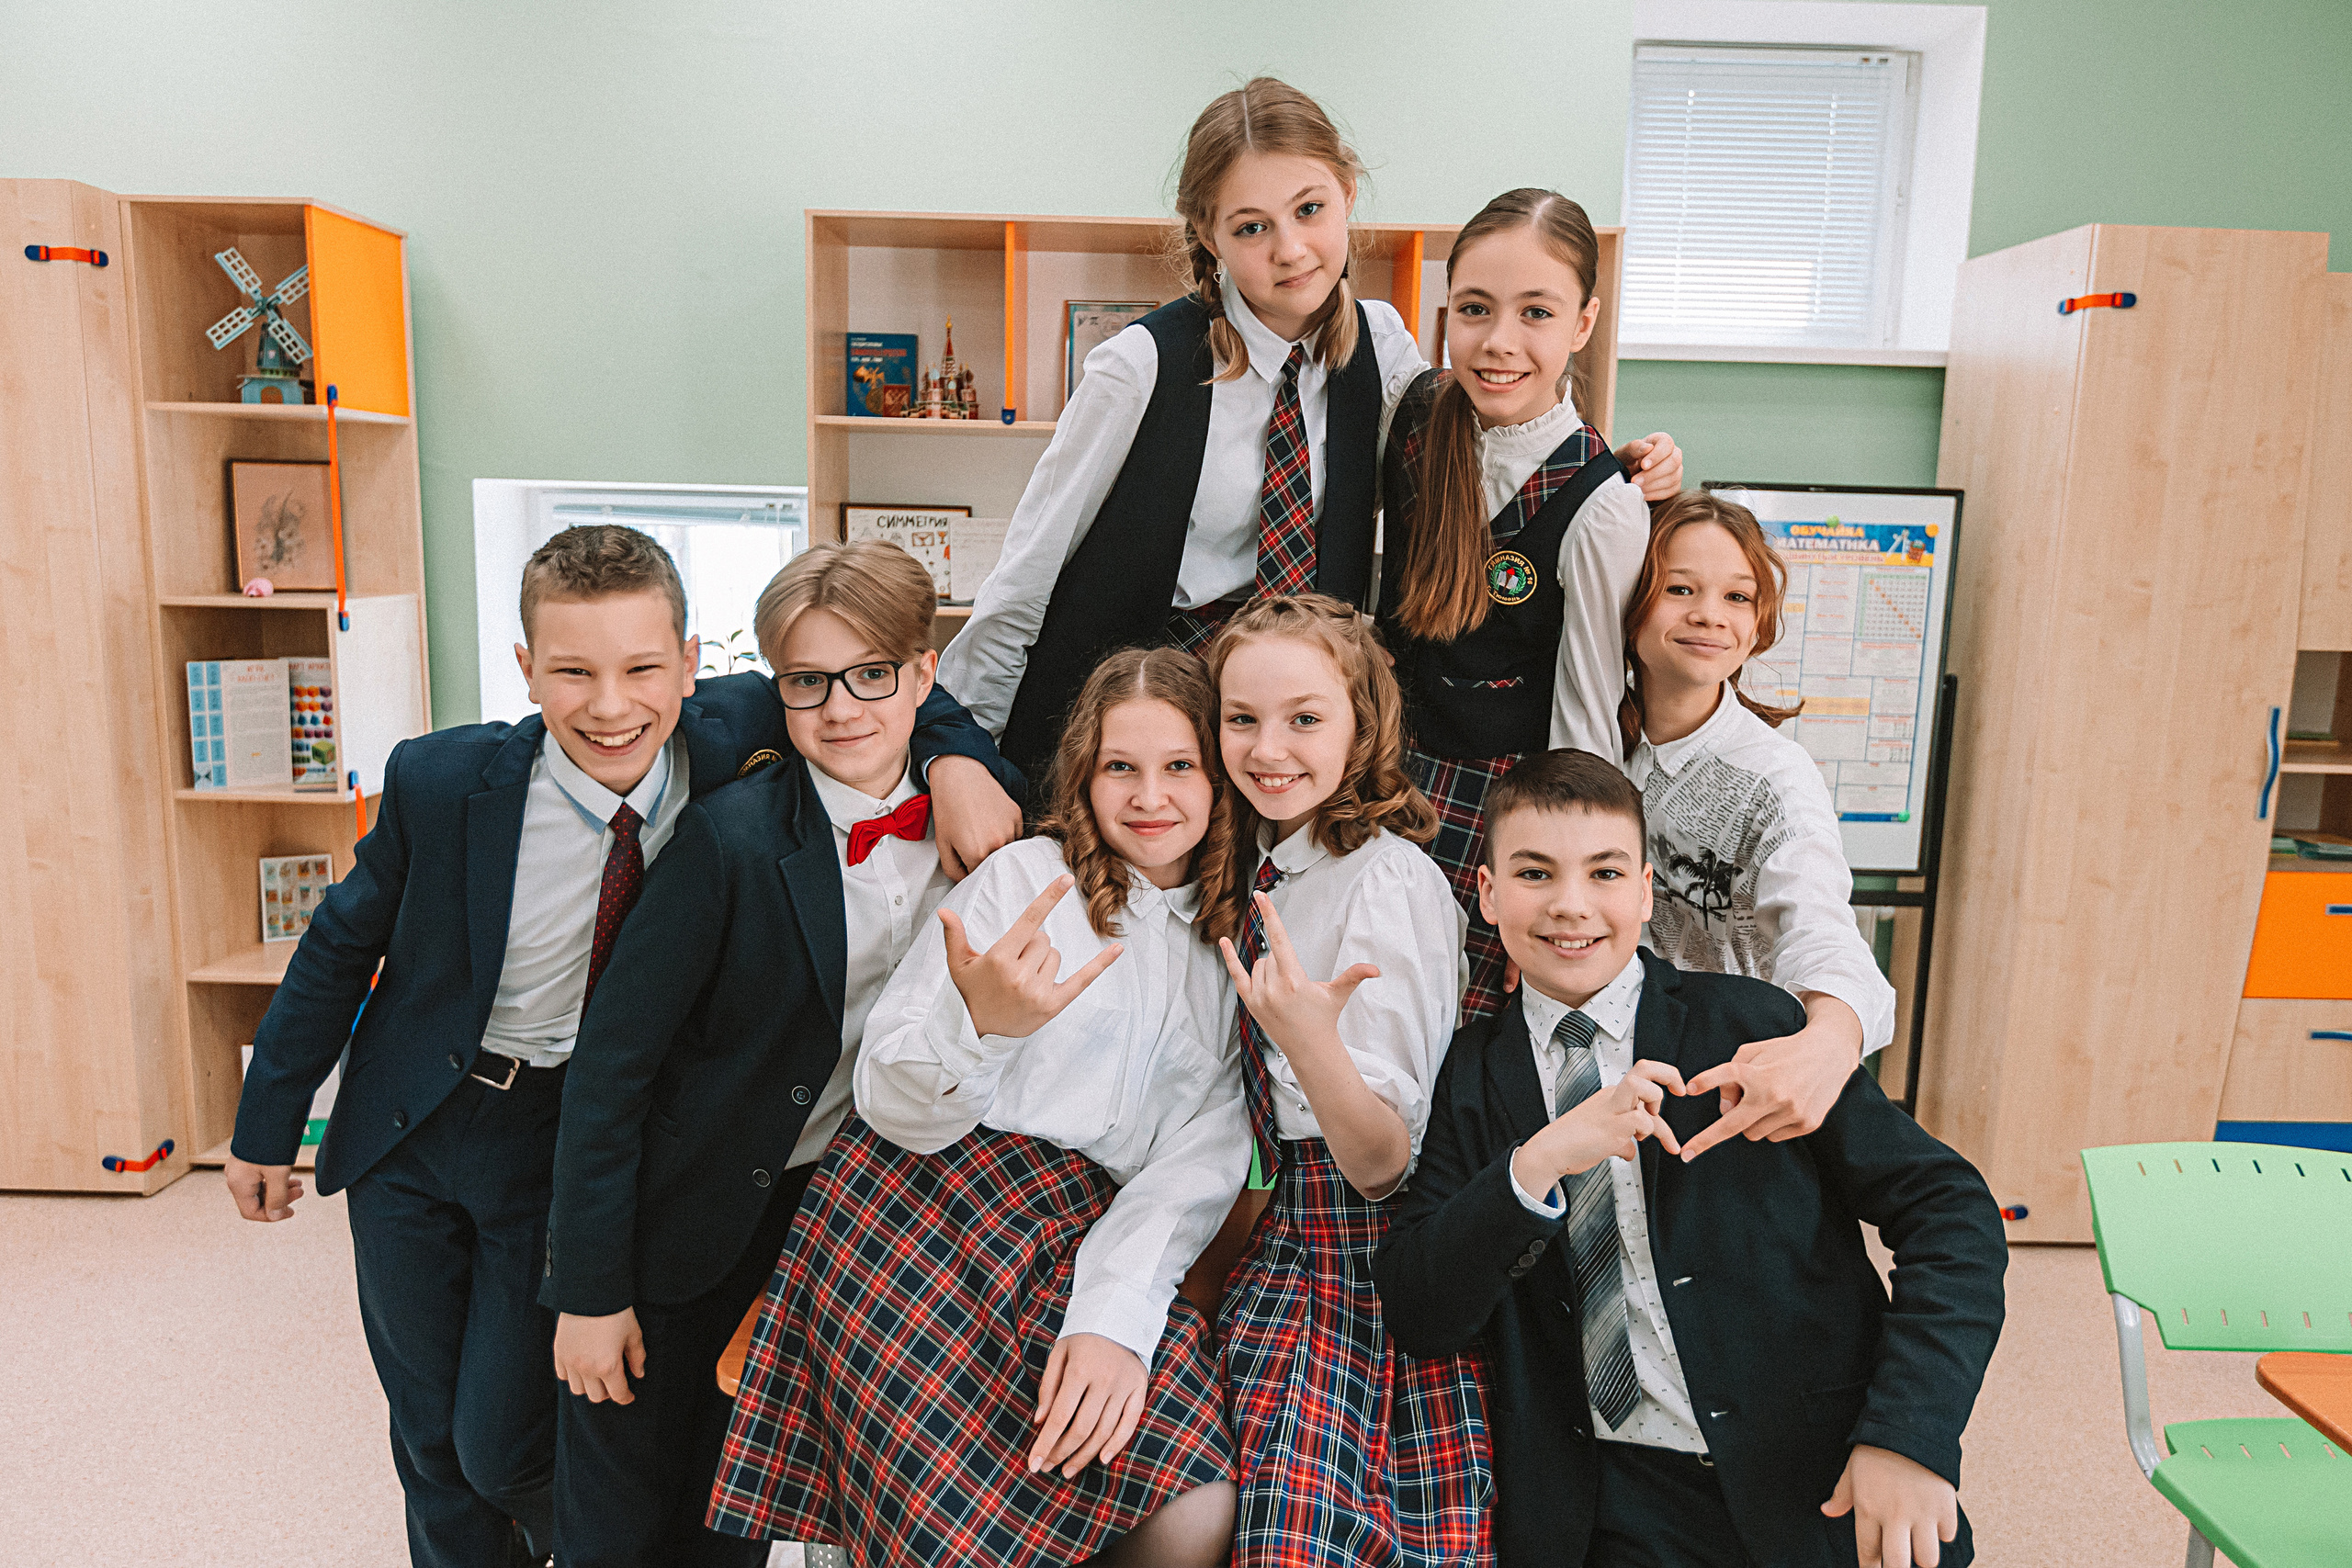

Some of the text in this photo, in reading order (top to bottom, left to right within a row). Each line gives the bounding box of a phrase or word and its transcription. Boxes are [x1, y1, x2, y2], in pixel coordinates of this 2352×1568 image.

[876, 515, 948, 529] СИММЕТРИЯ
[1773, 536, 1881, 551] МАТЕМАТИКА
[1488, 555, 1525, 570] ГИМНАЗИЯ
